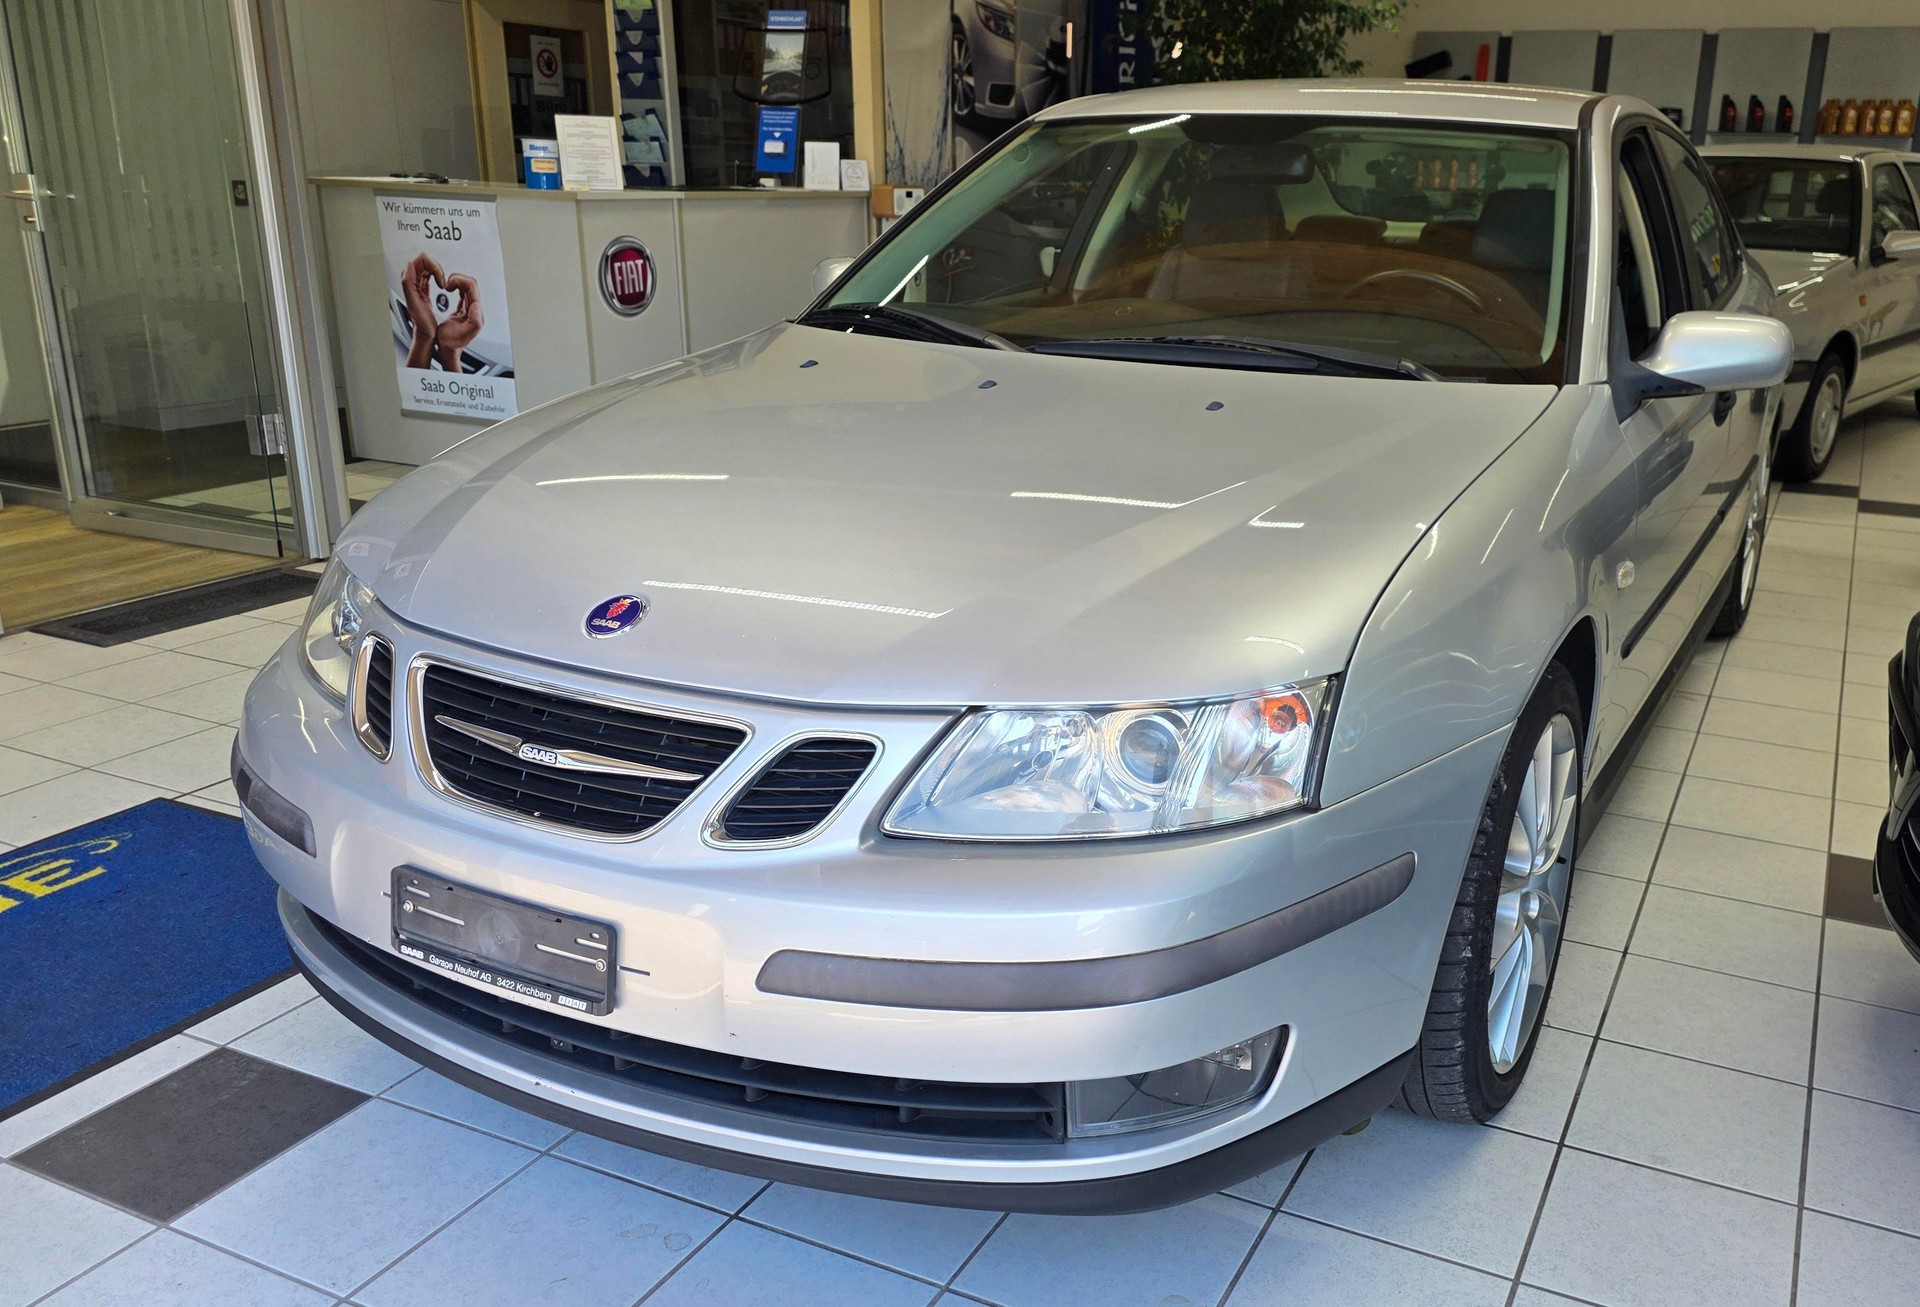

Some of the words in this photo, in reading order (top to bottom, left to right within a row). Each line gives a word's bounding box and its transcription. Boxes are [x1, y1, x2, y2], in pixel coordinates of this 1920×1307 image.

[382, 201, 401, 213] Wir
[403, 203, 446, 216] kümmern
[448, 208, 464, 217] uns
[466, 209, 481, 218] um
[397, 219, 420, 231] Ihren
[423, 218, 462, 241] Saab
[613, 258, 644, 296] FIAT
[420, 377, 445, 394] Saab
[448, 381, 495, 401] Original
[468, 402, 479, 410] und
[590, 618, 622, 629] SAAB
[521, 745, 557, 764] SAAB
[400, 945, 424, 960] SAAB
[429, 954, 454, 970] Garage
[454, 962, 480, 979] Neuhof
[480, 972, 492, 983] AG
[496, 977, 515, 990] 3422
[516, 983, 552, 1003] Kirchberg
